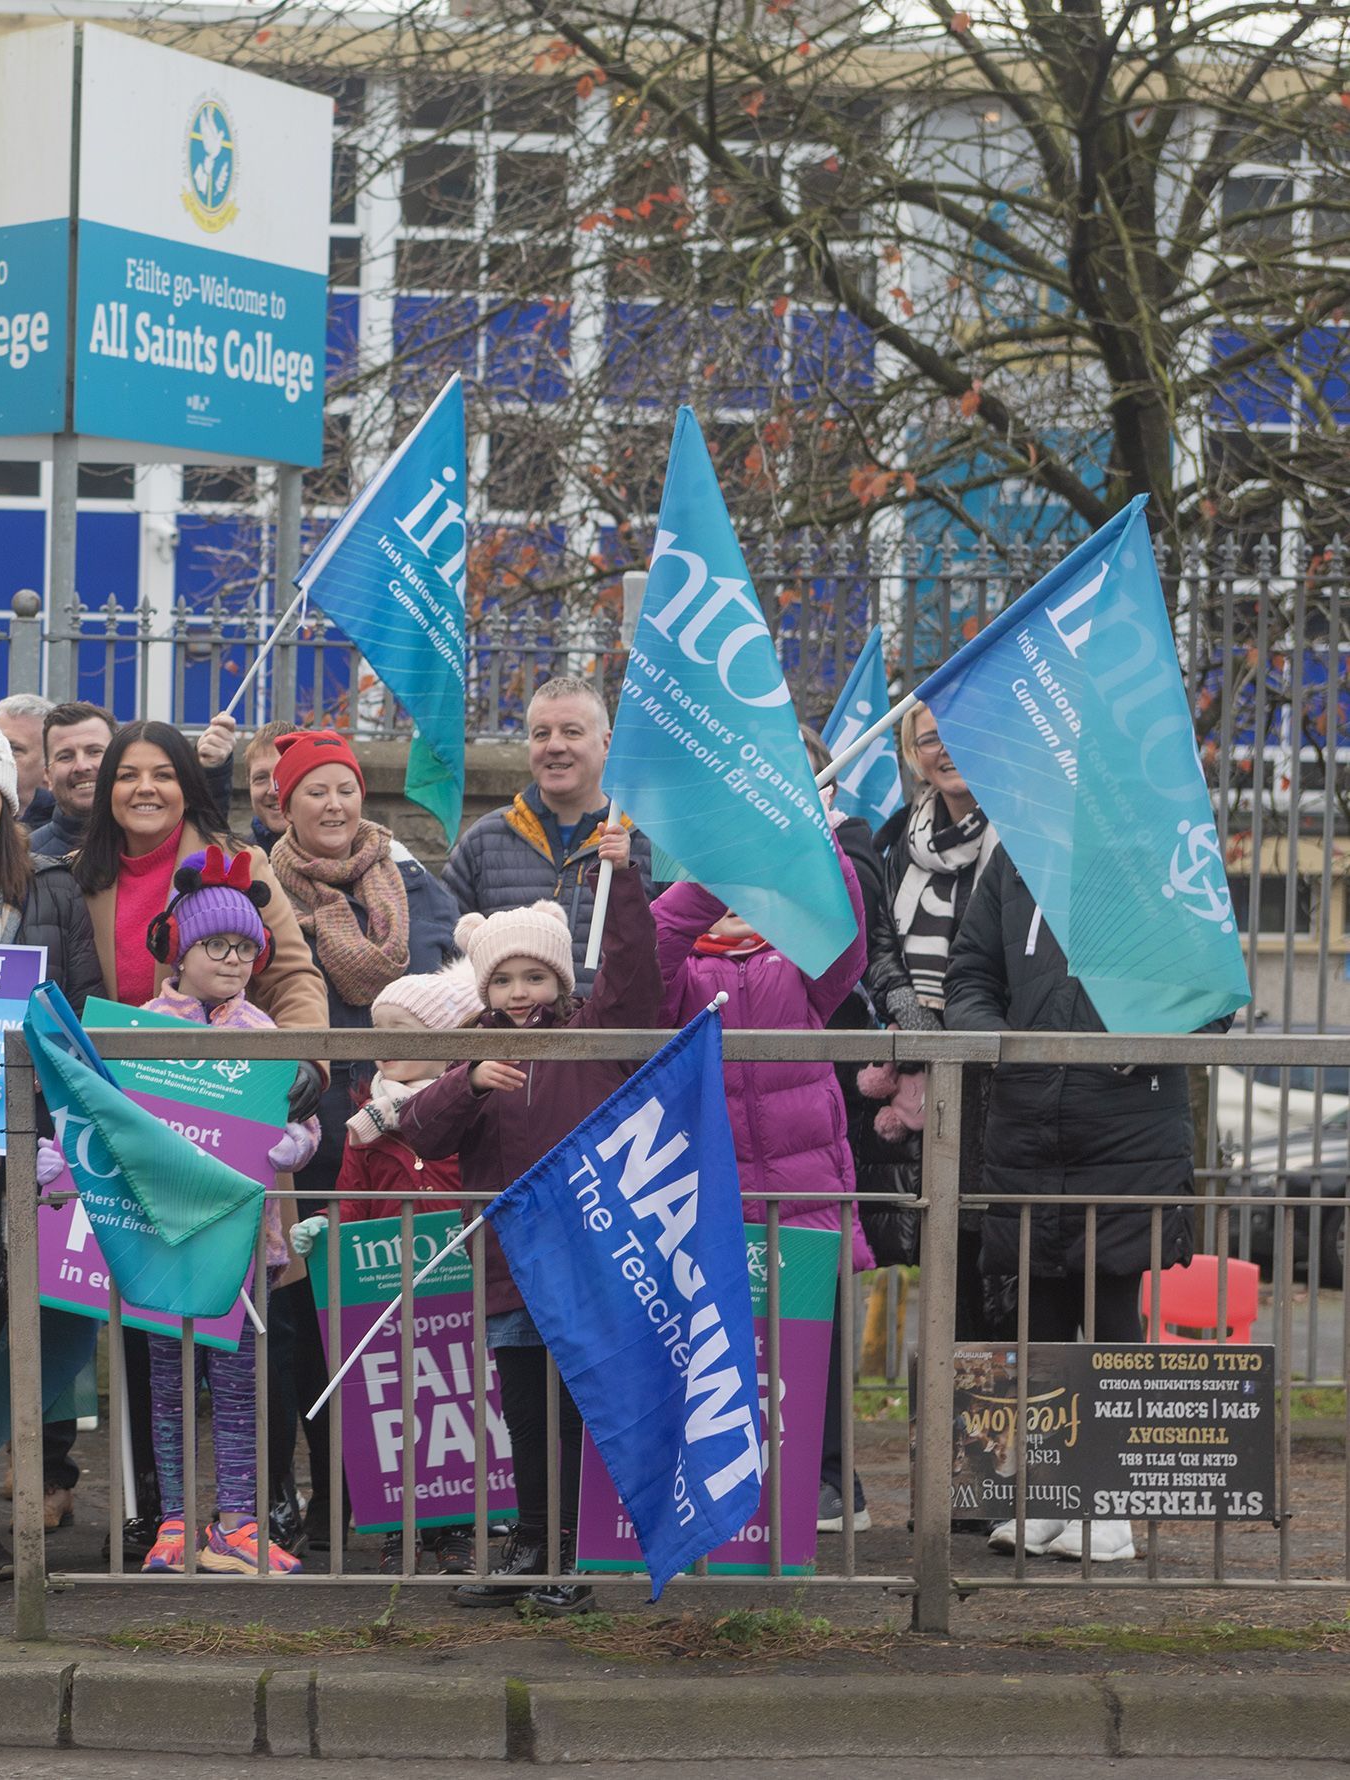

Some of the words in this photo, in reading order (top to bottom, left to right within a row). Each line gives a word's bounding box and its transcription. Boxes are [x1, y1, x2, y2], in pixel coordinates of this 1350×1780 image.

[126, 258, 170, 297] Fáilte
[270, 291, 286, 320] to
[89, 302, 128, 359] All
[134, 312, 217, 375] Saints
[223, 330, 314, 403] College
[377, 534, 402, 568] Irish
[400, 563, 444, 617] National
[388, 579, 429, 631] Cumann
[643, 529, 792, 709] nto
[1016, 628, 1039, 663] Irish
[1012, 678, 1061, 748] Cumann
[723, 768, 791, 830] Éireann
[120, 1060, 136, 1068] Irish
[137, 1063, 166, 1076] National
[199, 1078, 243, 1095] Organisation
[568, 1155, 613, 1232] The
[59, 1258, 83, 1283] in
[1092, 1353, 1155, 1371] 339980
[1158, 1353, 1209, 1371] 07521
[1214, 1353, 1262, 1371] CALL
[1099, 1379, 1142, 1391] WORLD
[1144, 1379, 1200, 1391] SLIMMING
[1202, 1379, 1240, 1391] JAMES
[1094, 1401, 1134, 1419] 7PM
[1144, 1401, 1209, 1419] 5:30PM
[1221, 1401, 1261, 1419] 4PM
[1126, 1427, 1229, 1444] THURSDAY
[1026, 1450, 1061, 1465] tast
[1118, 1453, 1143, 1466] 8BL
[1145, 1453, 1176, 1466] BT11
[1177, 1451, 1199, 1466] RD,
[1203, 1453, 1238, 1466] GLEN
[1130, 1472, 1169, 1486] HALL
[1172, 1472, 1227, 1486] PARISH
[1094, 1491, 1215, 1515] TERESAS
[1223, 1491, 1263, 1515] ST.
